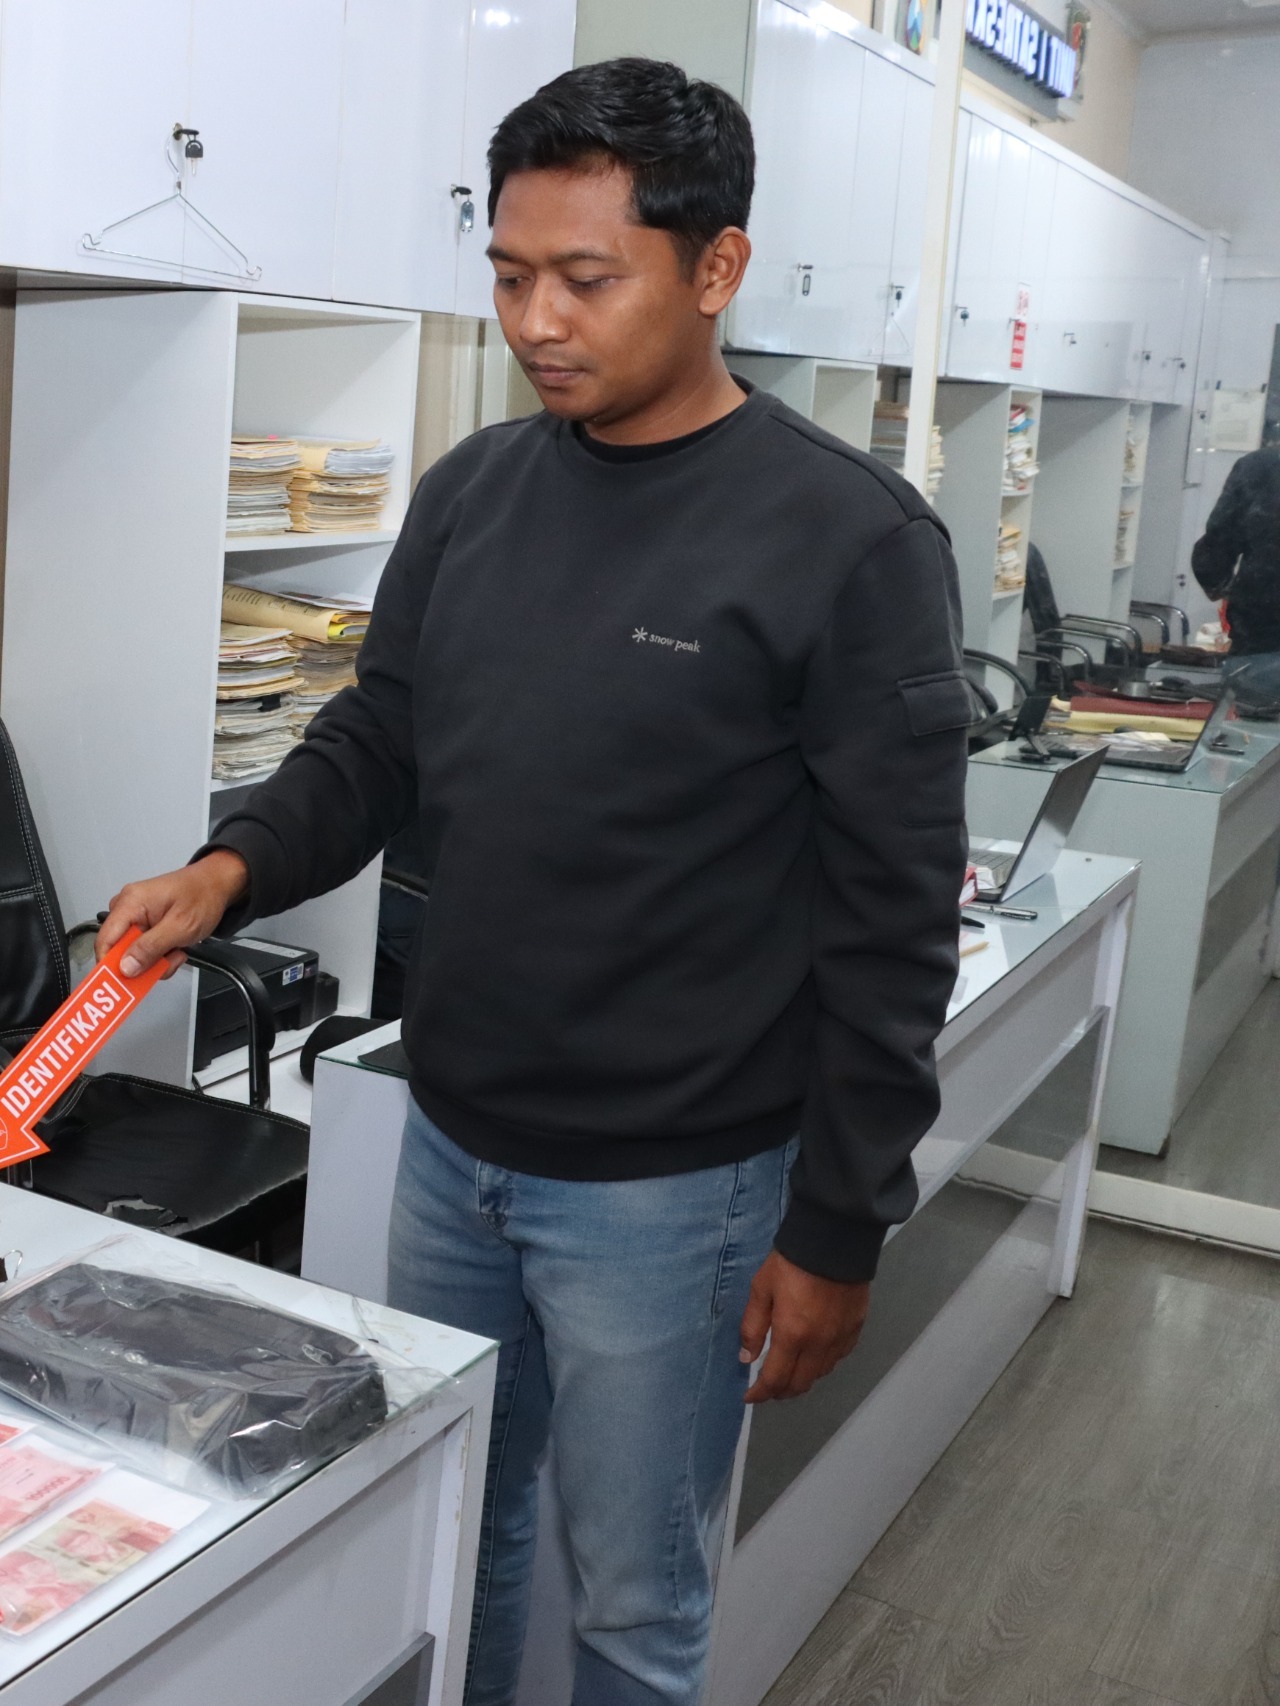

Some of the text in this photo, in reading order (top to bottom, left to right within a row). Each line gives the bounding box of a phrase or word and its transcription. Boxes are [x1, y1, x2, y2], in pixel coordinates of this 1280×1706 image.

[649, 634, 700, 653] snow peak
[0, 981, 121, 1118] IDENTIFIKASI
